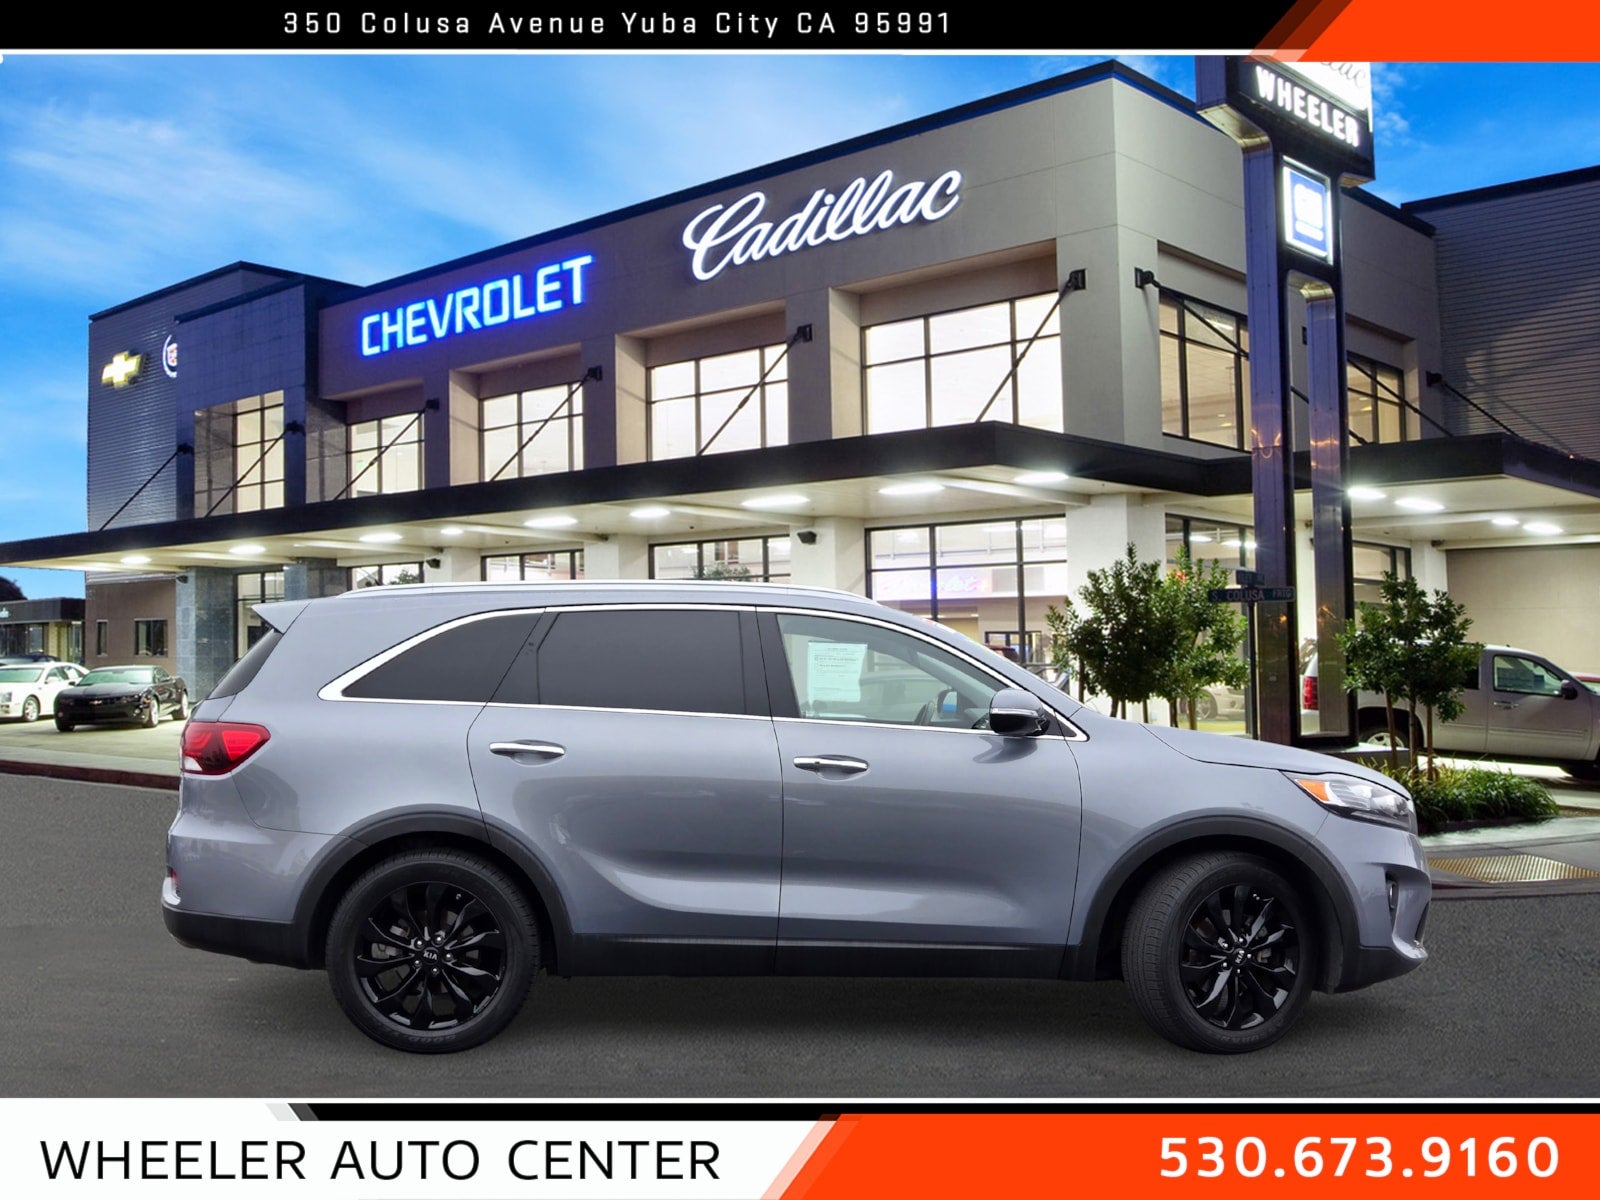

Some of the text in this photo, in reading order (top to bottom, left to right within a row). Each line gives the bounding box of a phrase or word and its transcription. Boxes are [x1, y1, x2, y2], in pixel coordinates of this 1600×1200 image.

[1255, 66, 1359, 147] WHEELER
[682, 169, 963, 281] Cadillac
[361, 254, 593, 357] CHEVROLET
[1226, 589, 1265, 602] COLUSA
[423, 951, 438, 960] KIA
